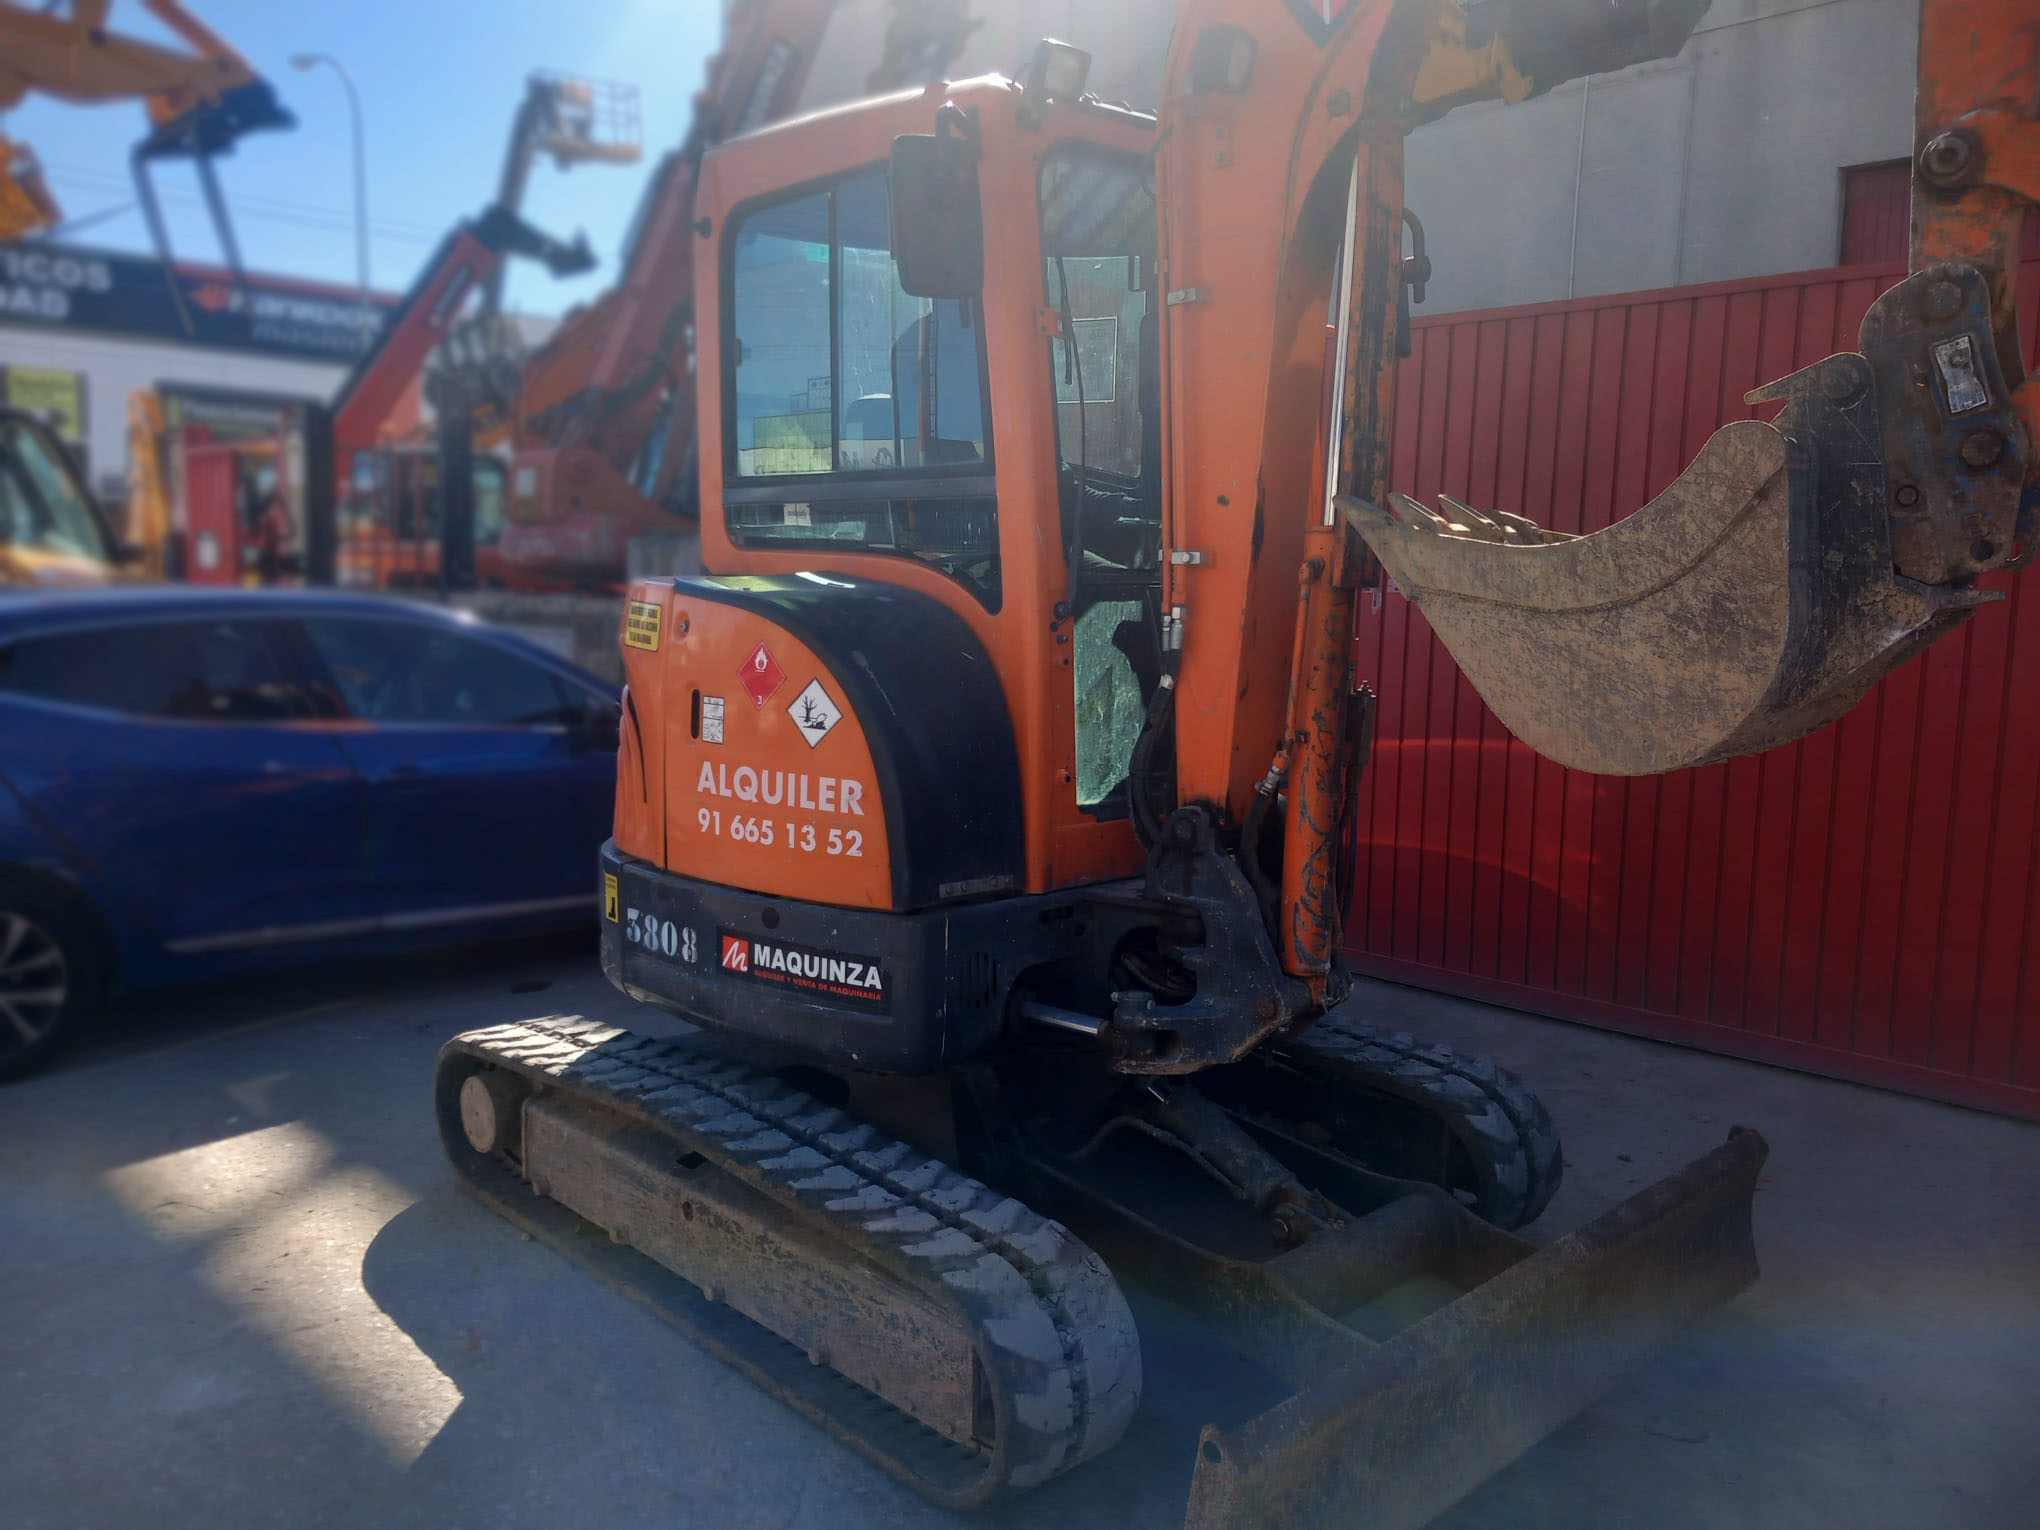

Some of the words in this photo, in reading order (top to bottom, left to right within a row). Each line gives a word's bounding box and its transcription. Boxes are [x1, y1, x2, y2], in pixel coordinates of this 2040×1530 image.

[757, 695, 763, 705] 3
[697, 761, 864, 815] ALQUILER
[698, 808, 720, 835] 91
[730, 815, 774, 845] 665
[786, 823, 816, 851] 13
[827, 829, 863, 857] 52
[626, 907, 698, 963] 3808
[754, 944, 882, 989] MAQUINZA
